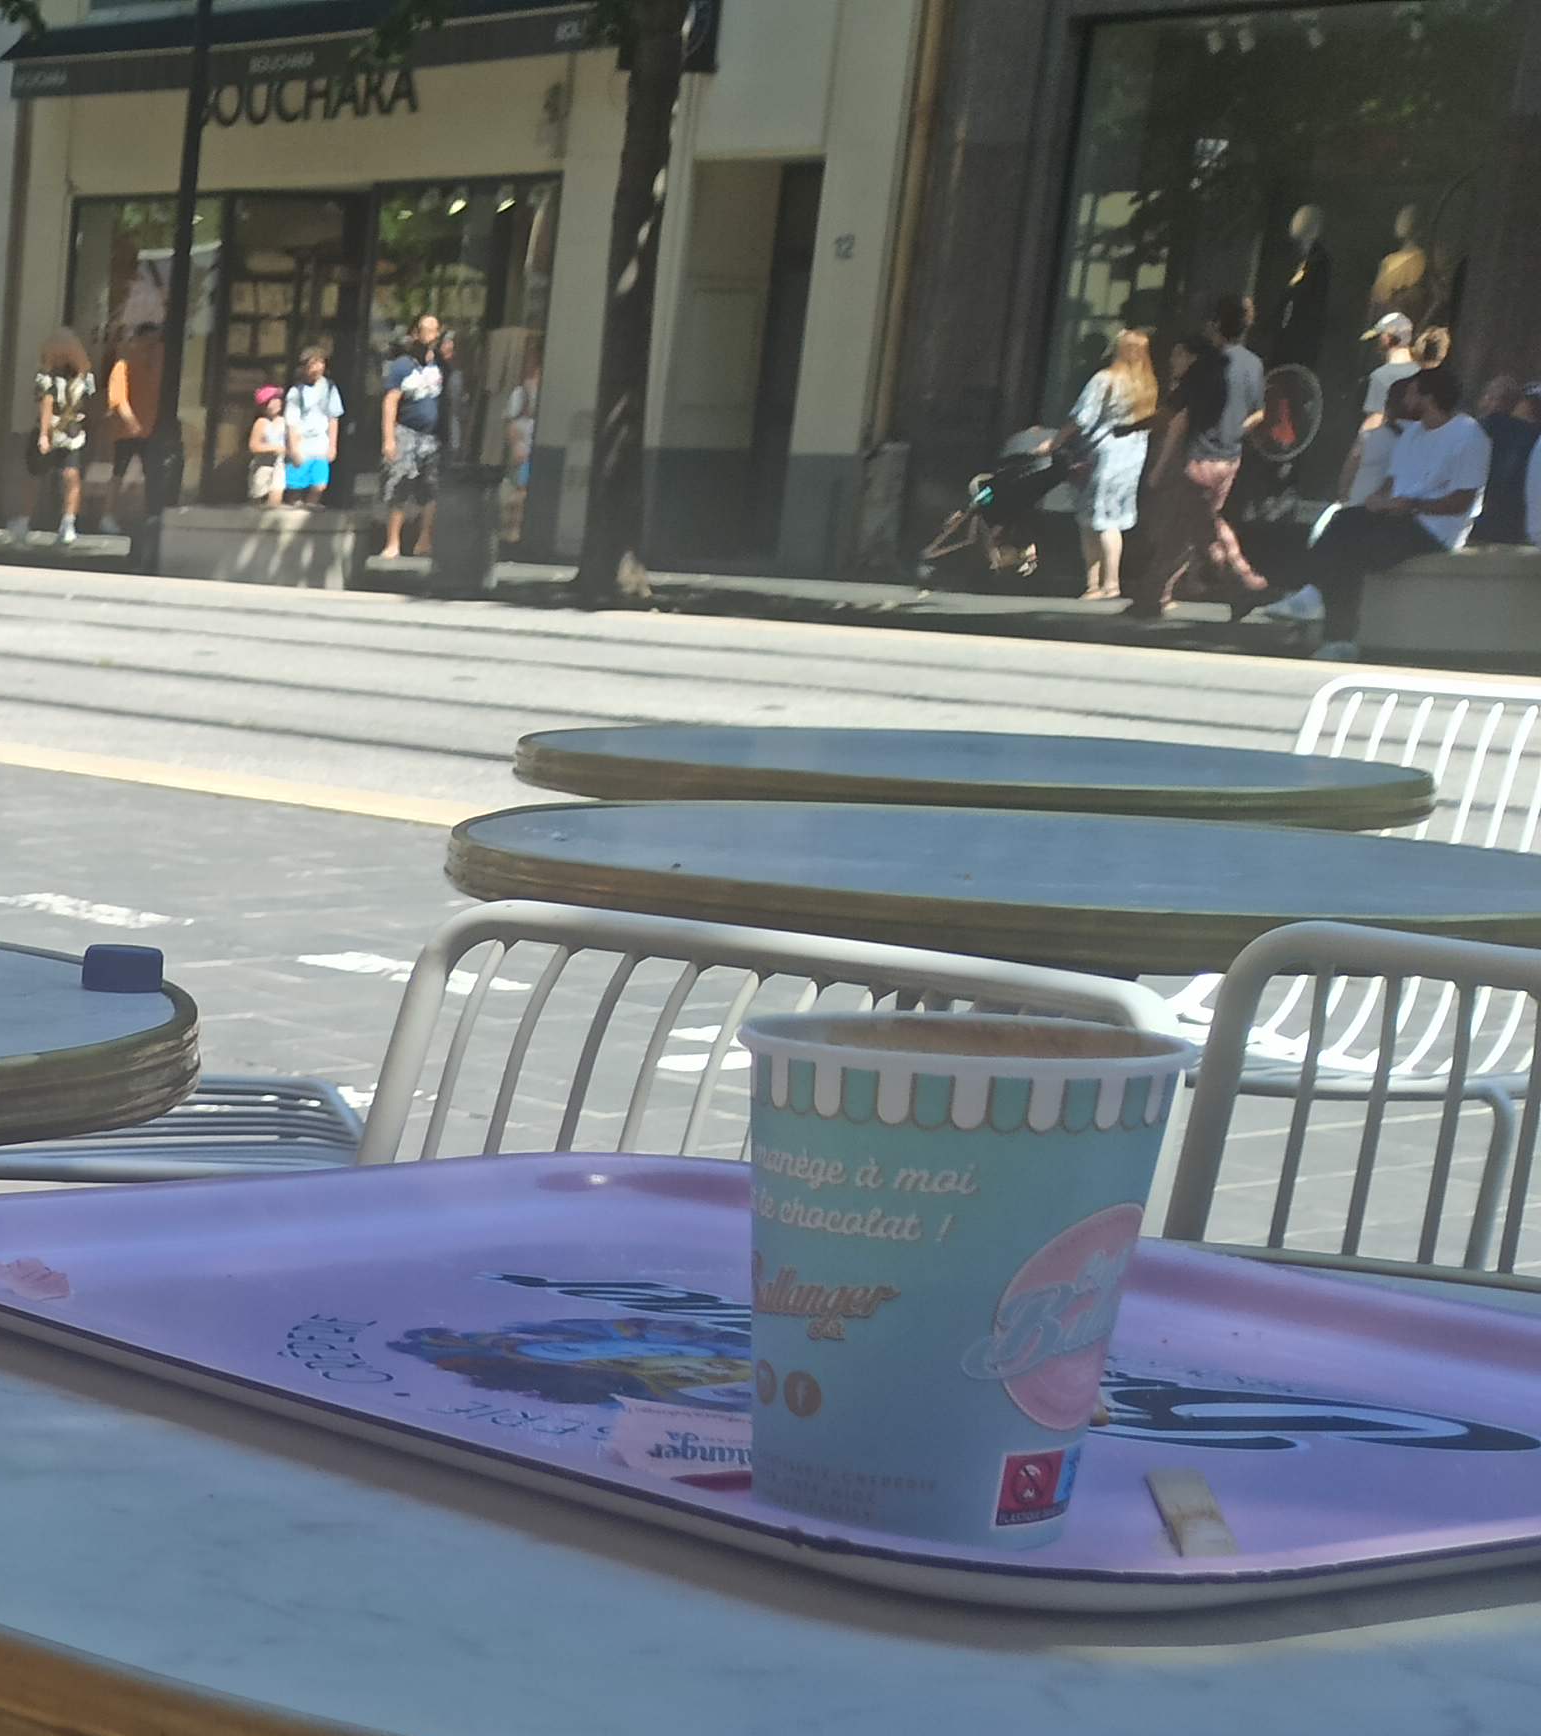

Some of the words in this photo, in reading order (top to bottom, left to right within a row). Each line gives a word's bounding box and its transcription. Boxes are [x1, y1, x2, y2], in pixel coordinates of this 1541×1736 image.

[201, 67, 418, 127] OUCHARA
[855, 1157, 884, 1188] à
[893, 1164, 979, 1194] moi
[779, 1197, 922, 1241] chocolat
